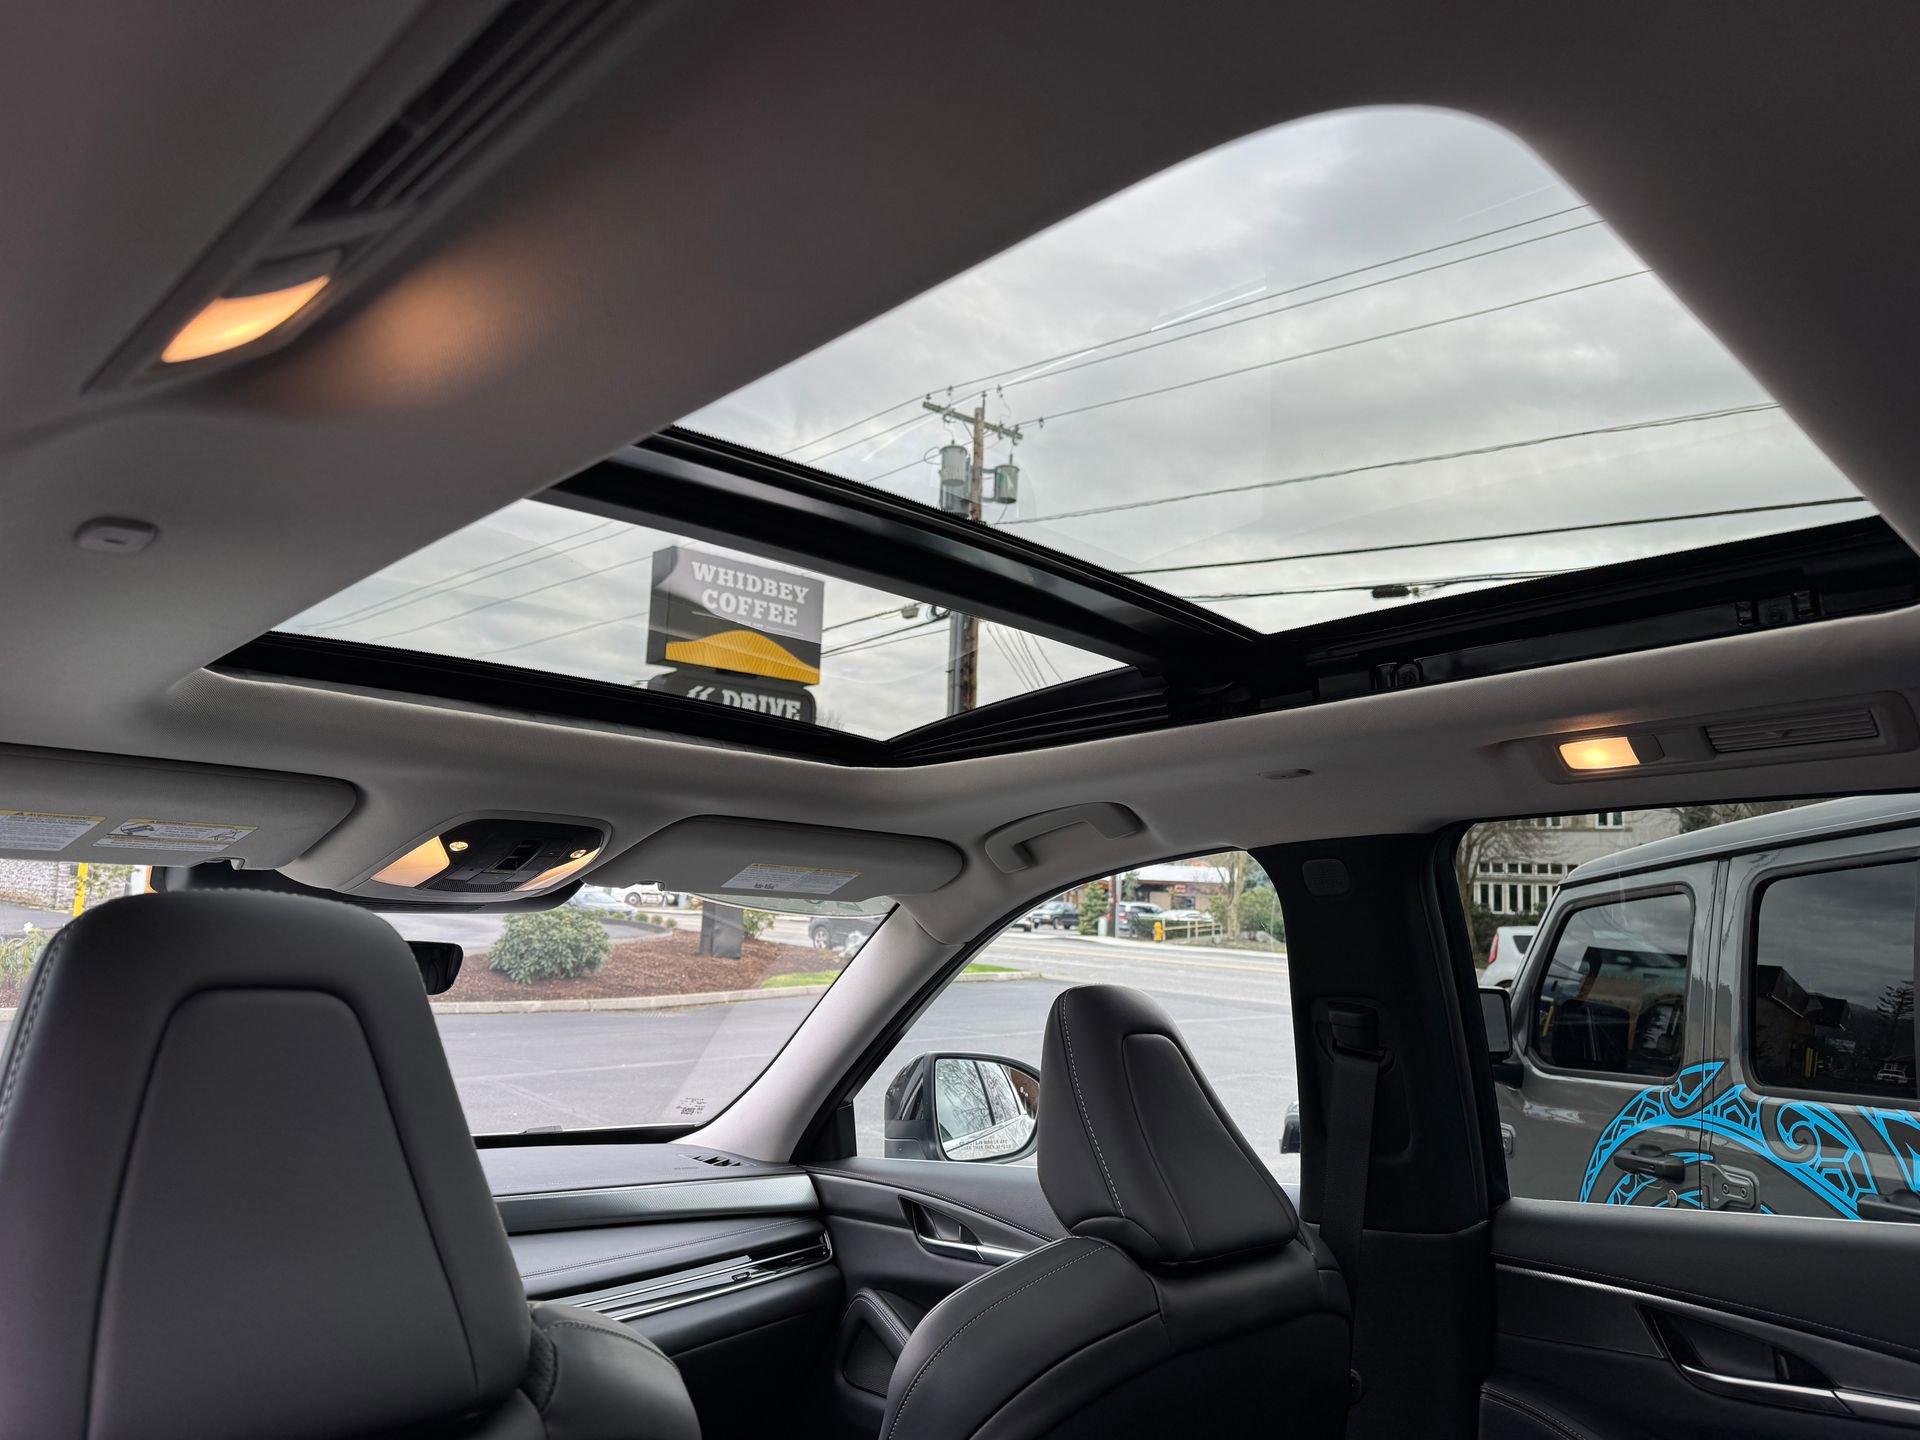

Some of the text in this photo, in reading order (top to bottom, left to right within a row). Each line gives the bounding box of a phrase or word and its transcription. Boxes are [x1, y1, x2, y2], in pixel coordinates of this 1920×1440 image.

[691, 561, 809, 604] WHIDBEY
[702, 589, 798, 626] COFFEE
[722, 689, 801, 720] DRIVE
